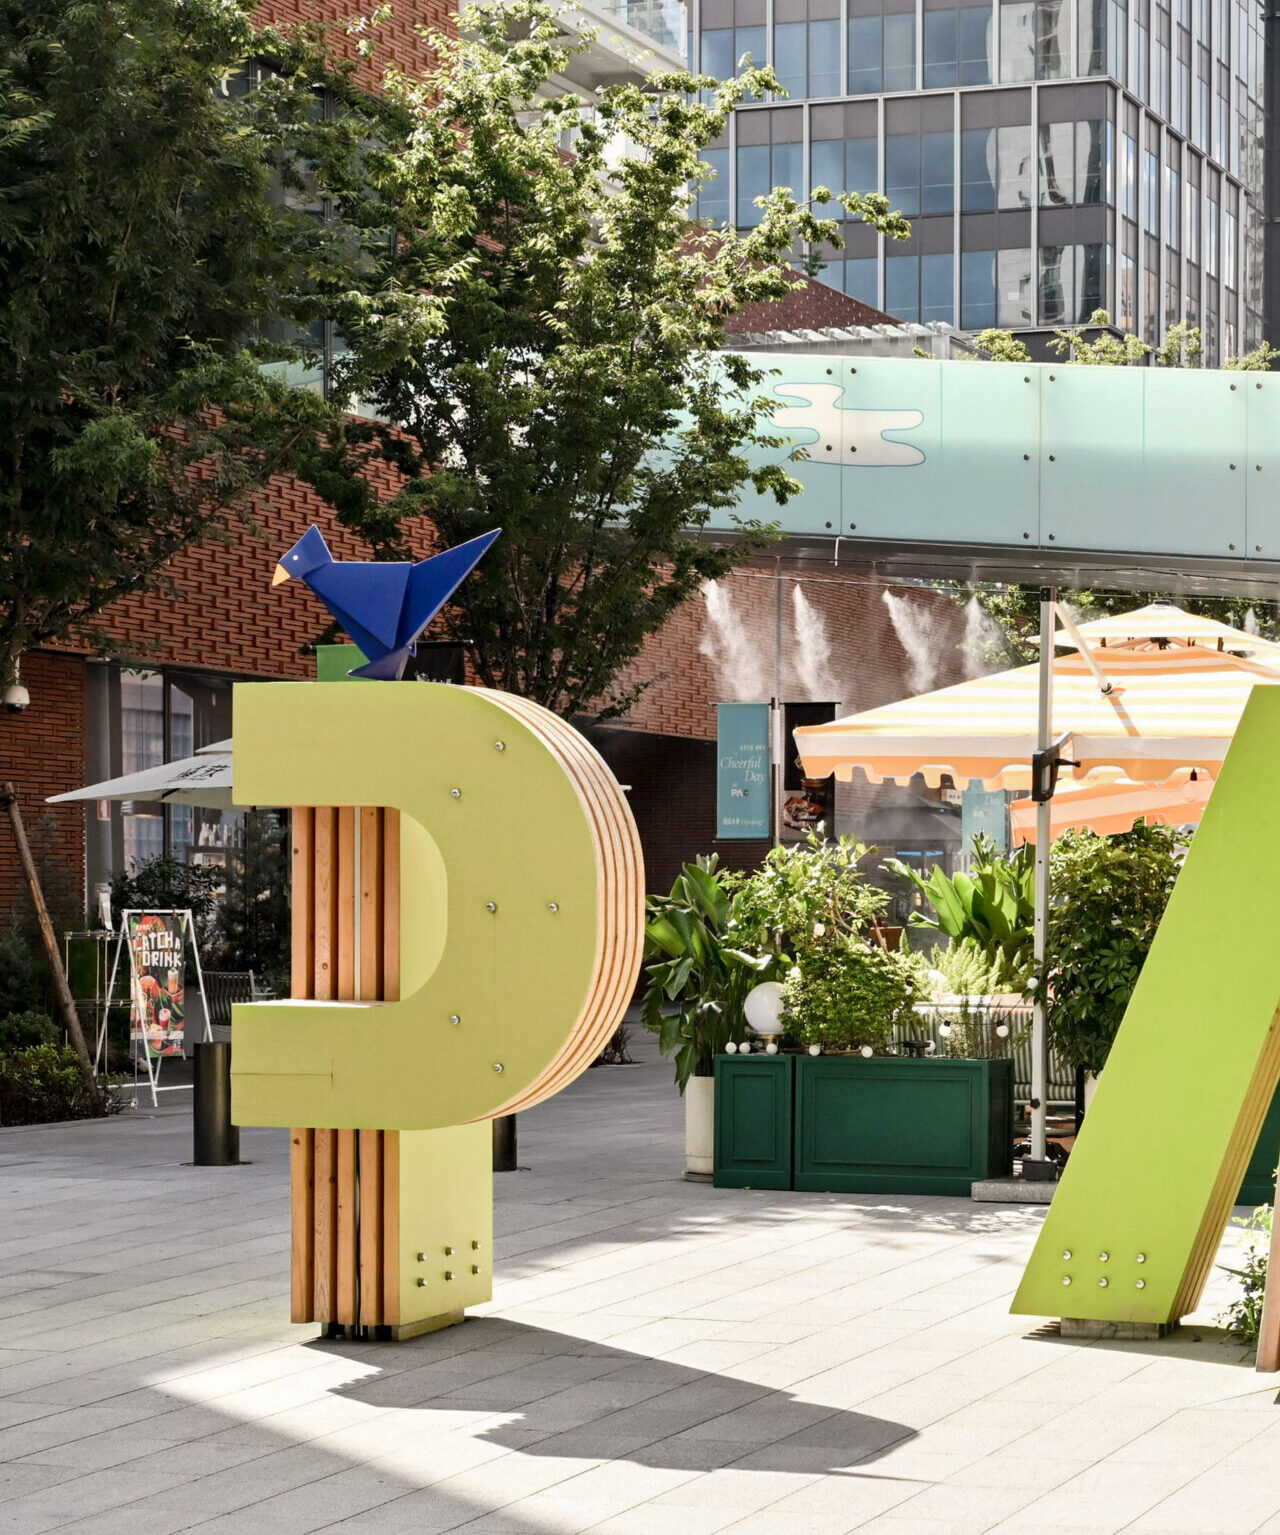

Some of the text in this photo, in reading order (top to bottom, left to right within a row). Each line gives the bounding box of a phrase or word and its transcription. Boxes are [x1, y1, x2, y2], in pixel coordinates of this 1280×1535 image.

[720, 755, 761, 769] Cheerful
[745, 770, 766, 785] Day
[142, 951, 182, 967] DRINK
